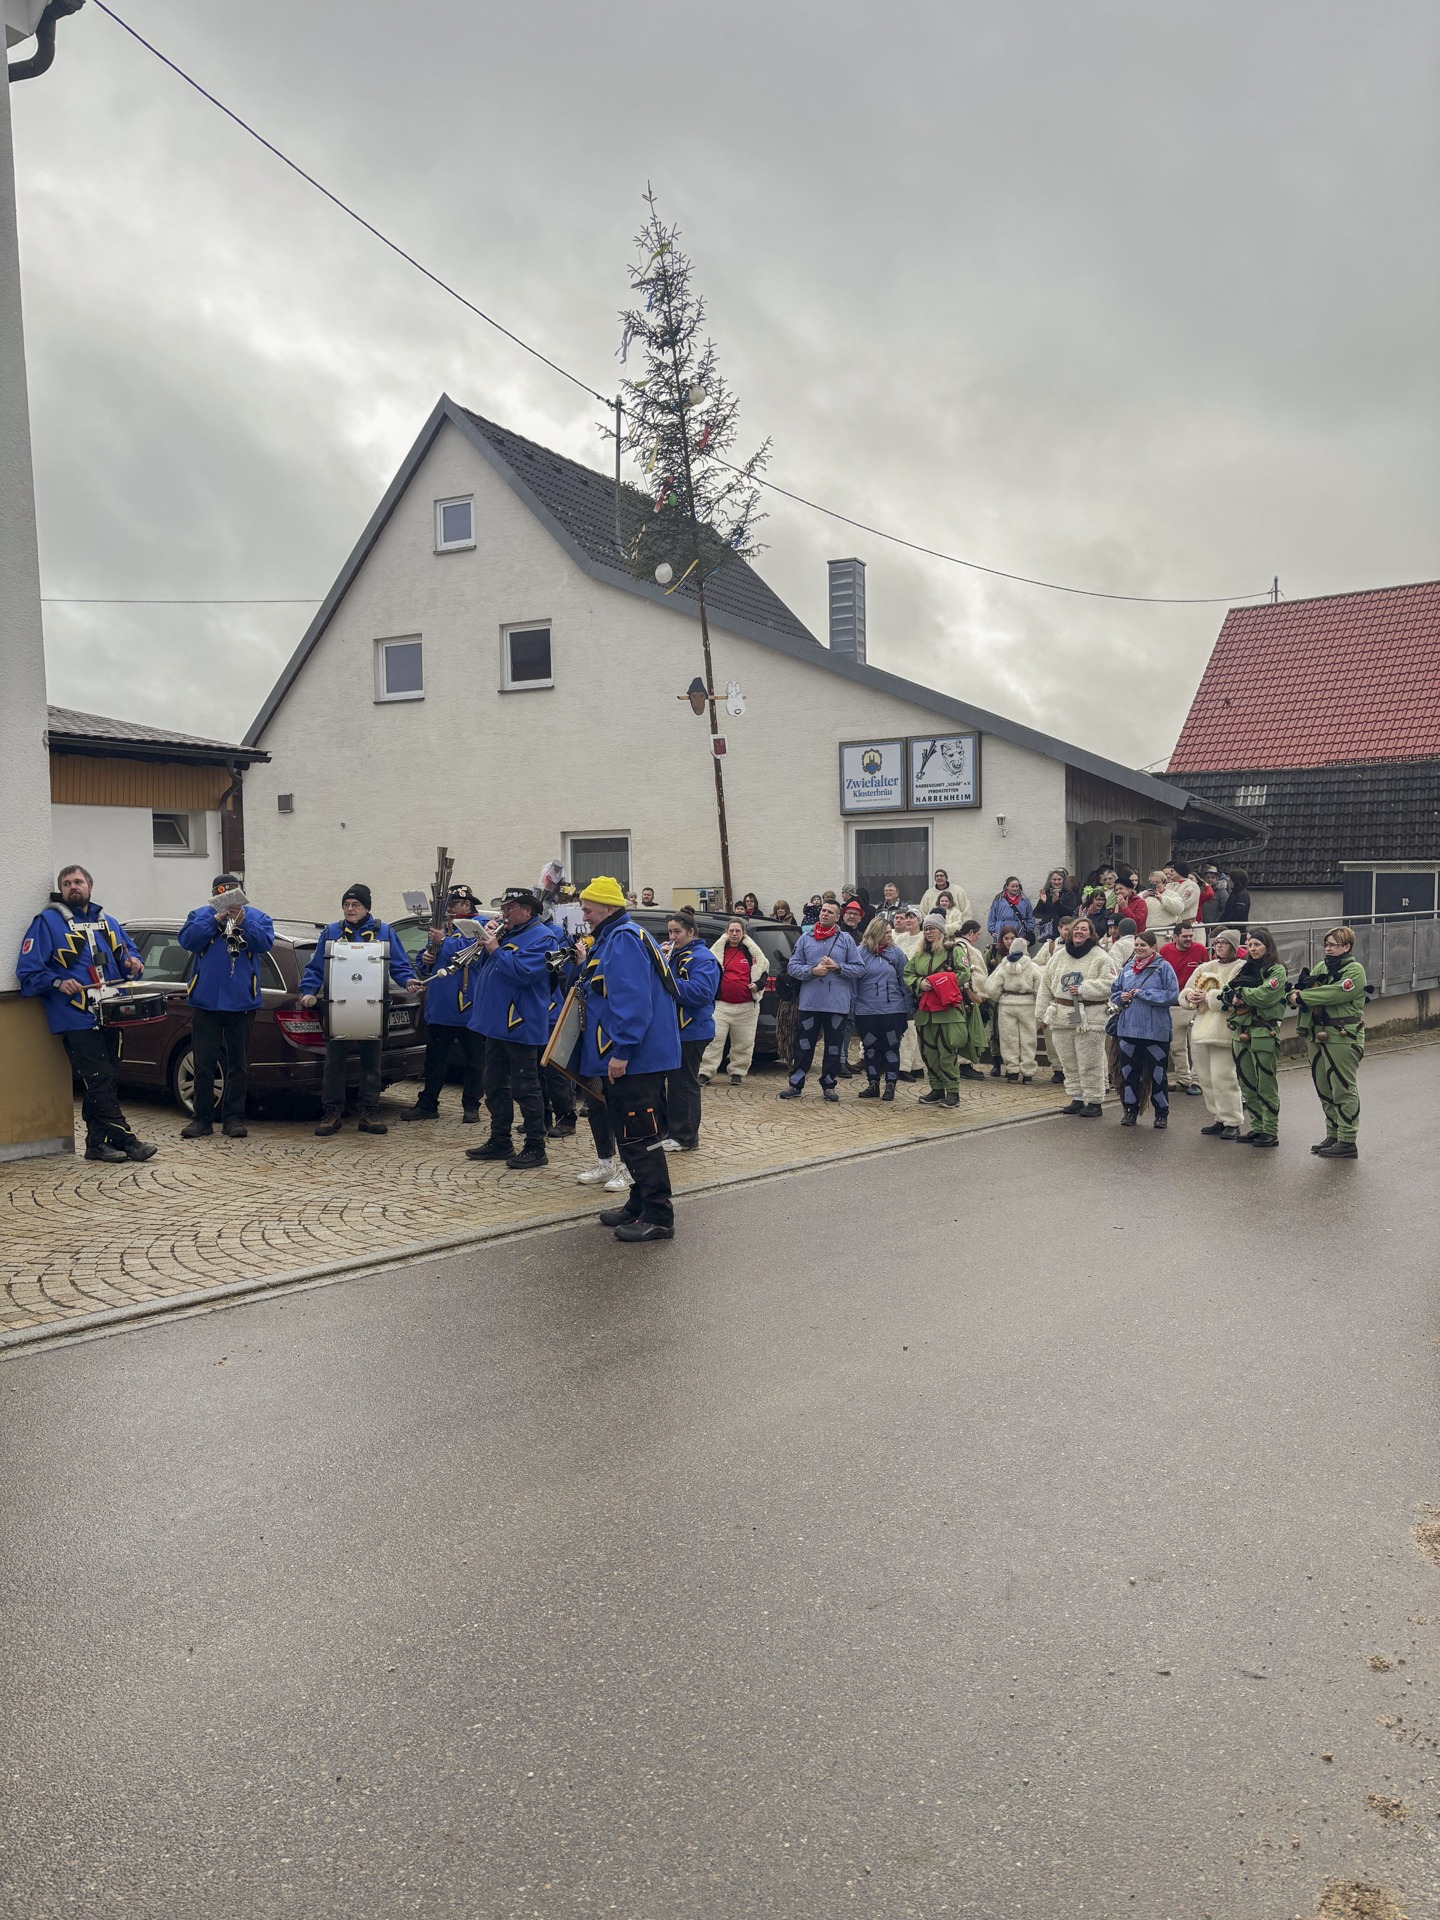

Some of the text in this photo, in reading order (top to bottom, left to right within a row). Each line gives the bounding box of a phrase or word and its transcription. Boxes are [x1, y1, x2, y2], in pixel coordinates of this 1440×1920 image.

[846, 775, 899, 789] Zwiefalter
[853, 788, 893, 798] Klosterbräu
[915, 794, 971, 803] NARRENHEIM
[391, 1012, 409, 1024] 1961
